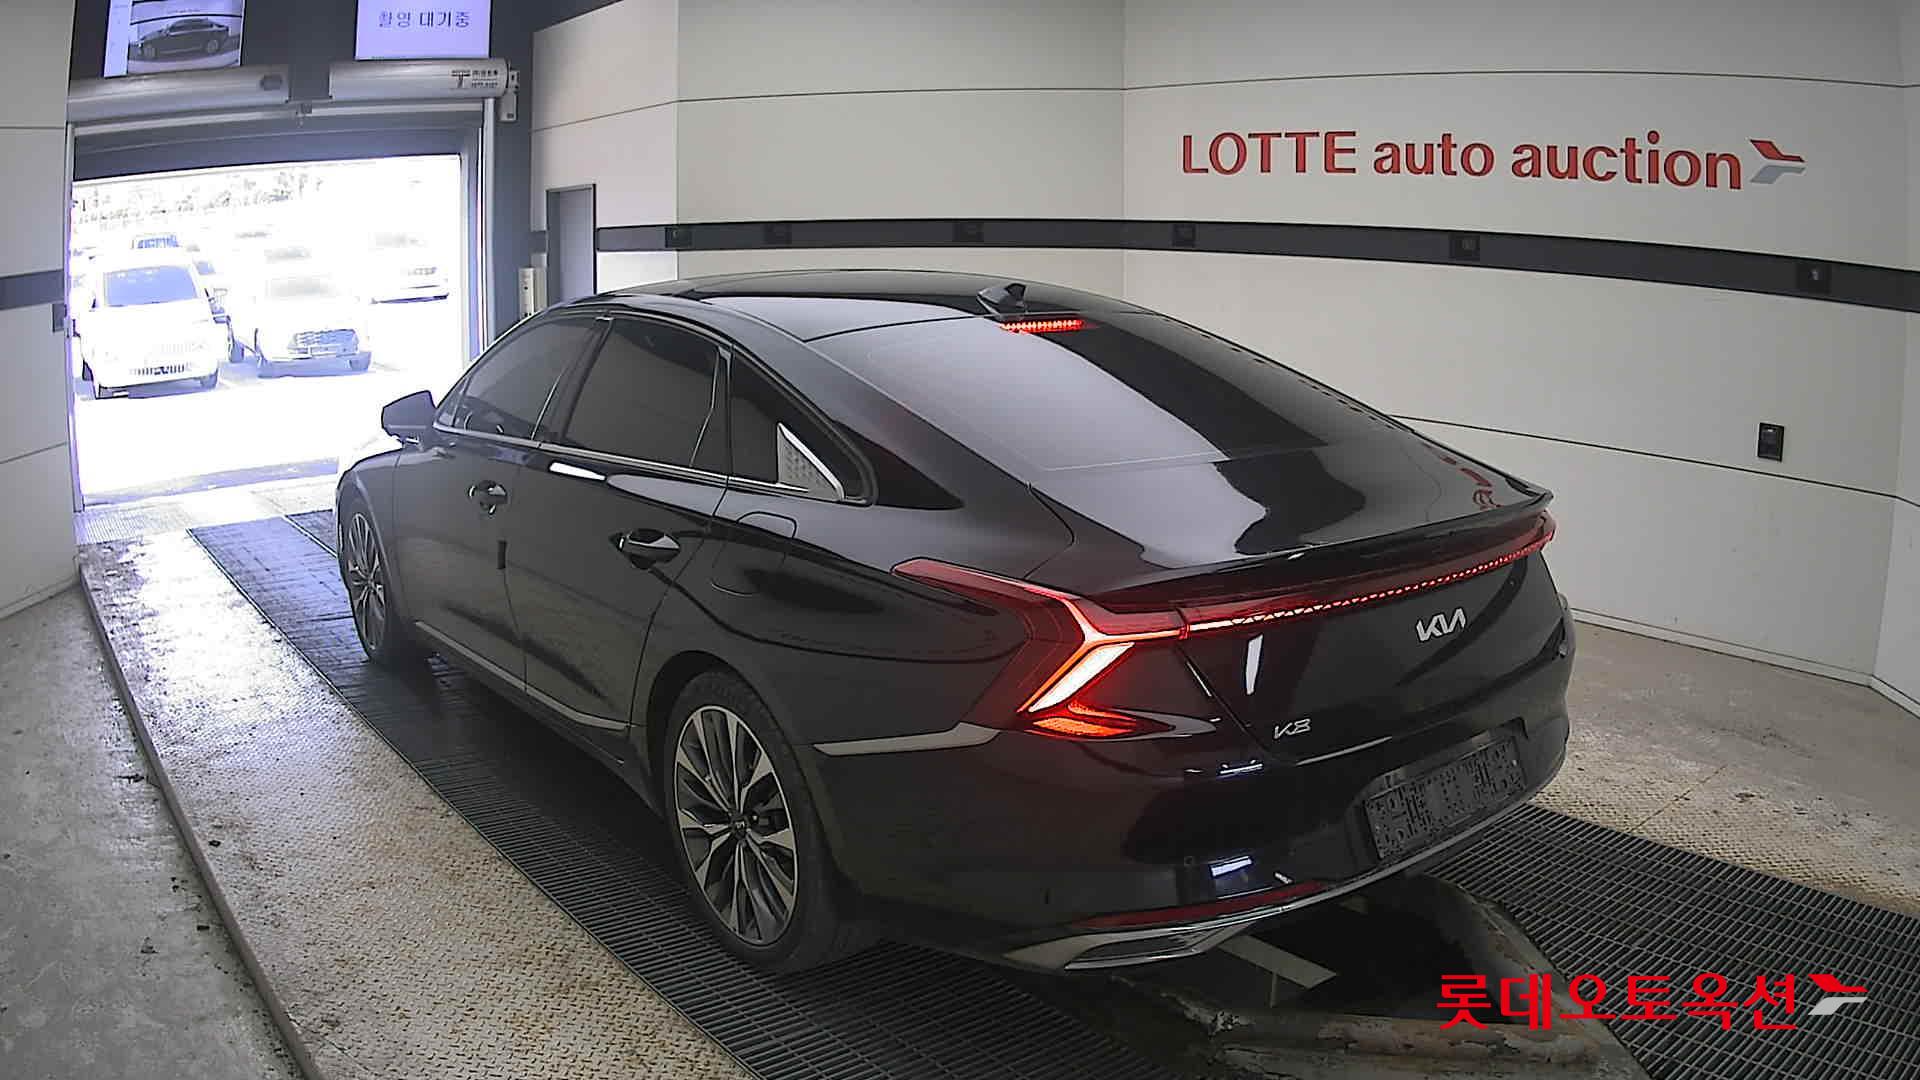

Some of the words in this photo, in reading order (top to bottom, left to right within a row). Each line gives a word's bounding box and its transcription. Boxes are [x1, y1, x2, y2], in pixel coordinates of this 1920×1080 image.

[419, 11, 470, 28] 대기중
[1182, 131, 1357, 175] LOTTE
[1373, 132, 1495, 177] auto
[1511, 130, 1742, 190] auction
[1416, 608, 1467, 642] KIA
[1273, 718, 1312, 740] K8
